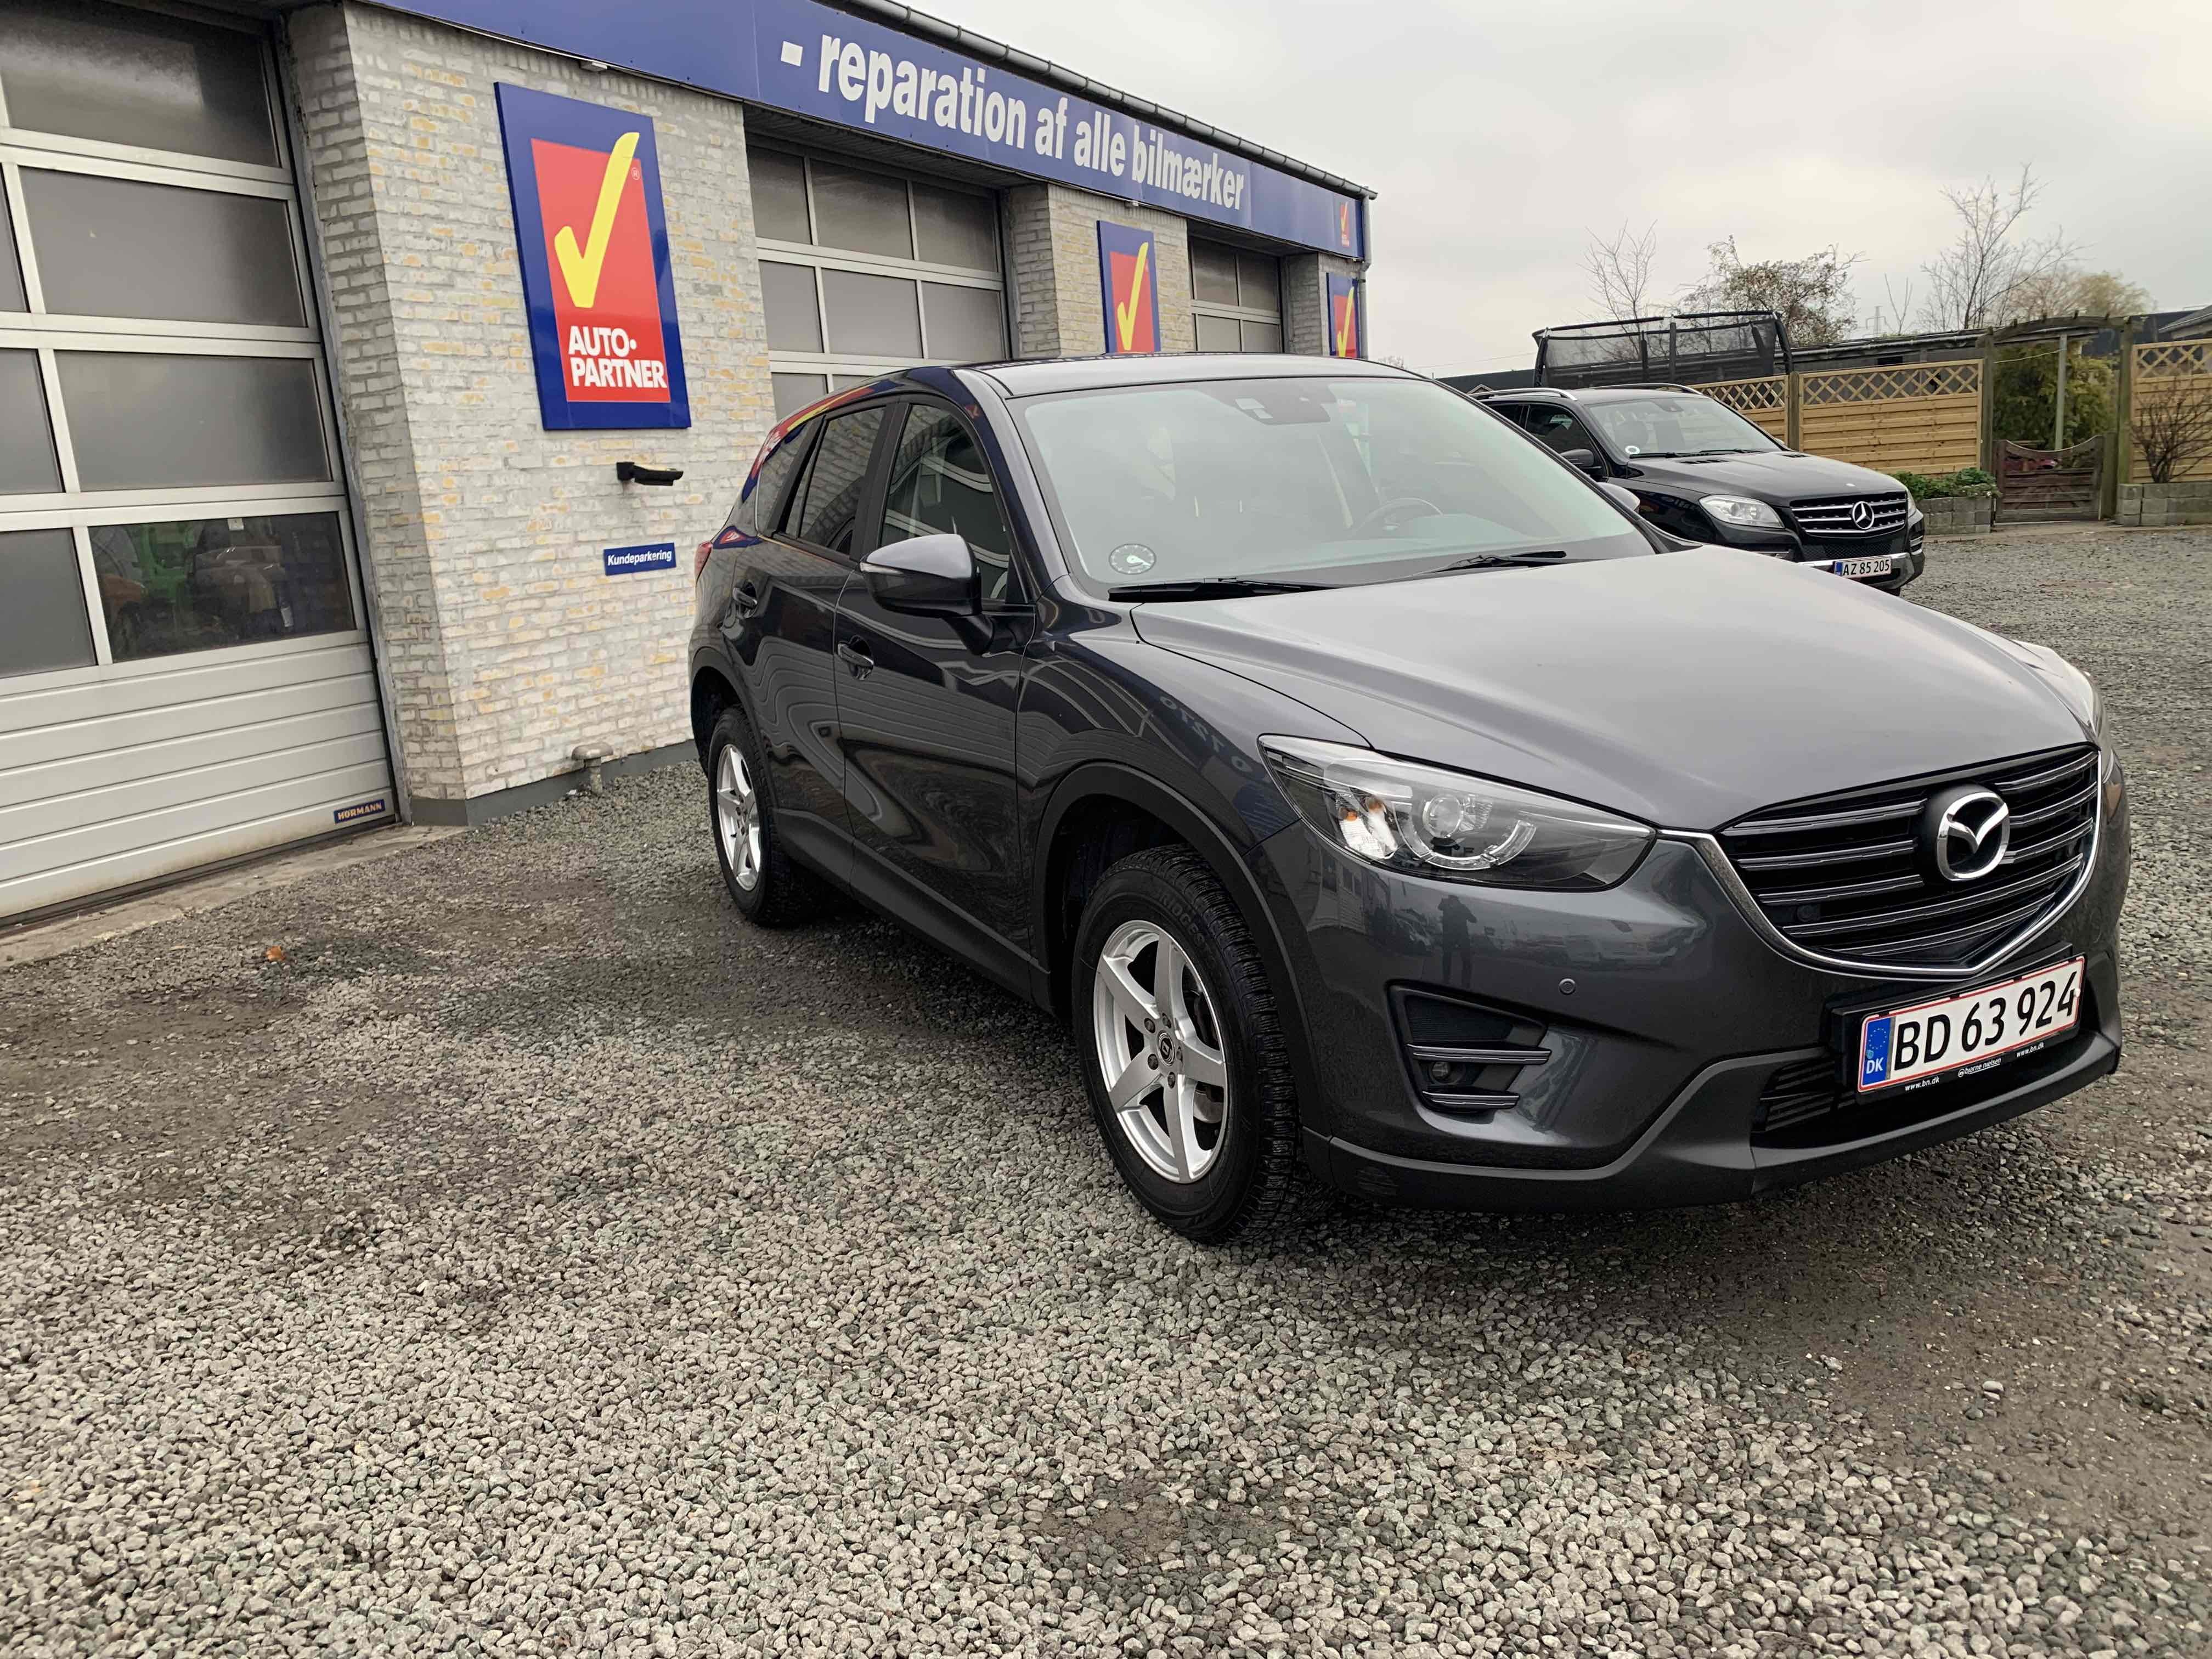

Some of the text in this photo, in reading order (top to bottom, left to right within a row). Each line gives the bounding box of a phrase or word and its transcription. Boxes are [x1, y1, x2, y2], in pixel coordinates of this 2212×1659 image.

[818, 33, 1026, 149] reparation
[1035, 95, 1067, 160] af
[1074, 111, 1126, 177] alle
[1132, 125, 1245, 210] bilmærker
[571, 358, 667, 388] PARTNER
[607, 550, 672, 566] Kundeparkering
[1843, 559, 1890, 576] AZ 85 205
[1894, 971, 2078, 1070] BD 63 924
[2017, 1042, 2044, 1058] www.bn.dk
[1866, 1058, 1883, 1074] DK
[1905, 1076, 1940, 1091] www.bn.dk
